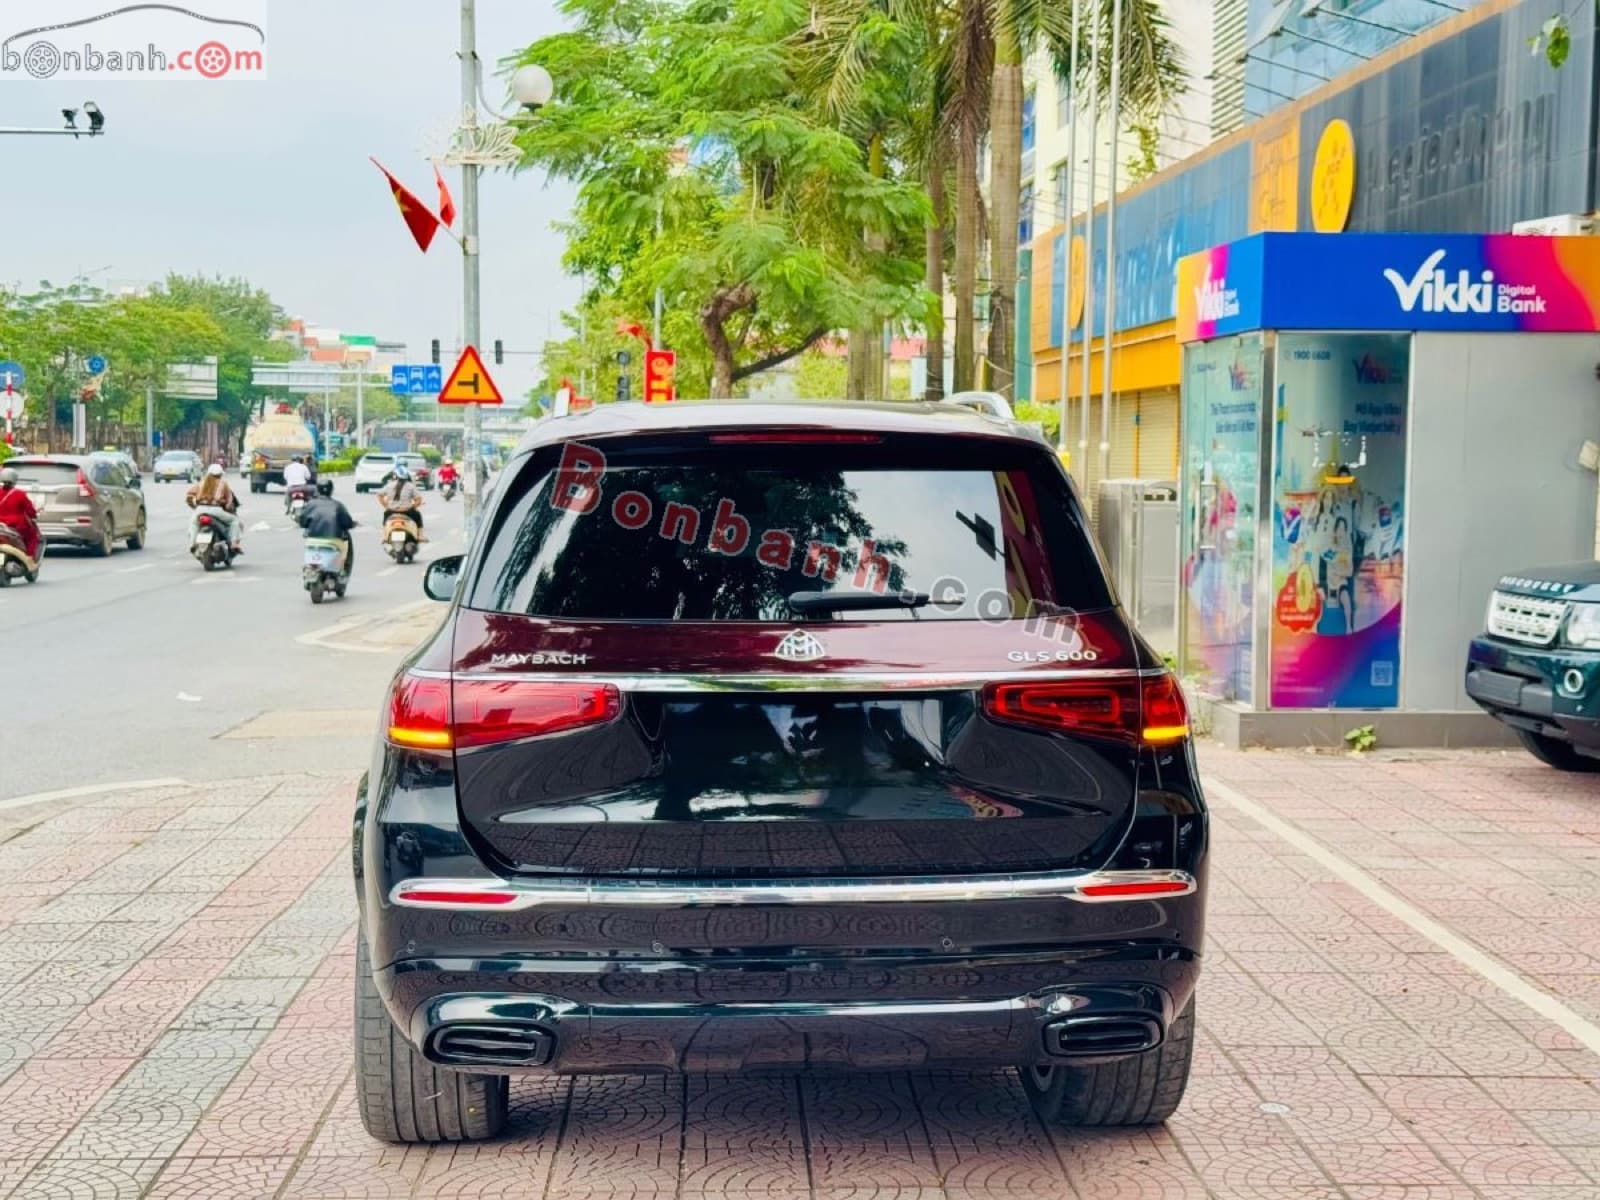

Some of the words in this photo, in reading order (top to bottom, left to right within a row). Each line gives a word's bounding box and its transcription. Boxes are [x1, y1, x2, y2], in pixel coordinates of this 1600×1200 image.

[1384, 249, 1494, 313] Vikki
[1497, 284, 1536, 297] Digital
[1497, 296, 1547, 313] Bank
[490, 653, 587, 665] MAYBACH
[1007, 650, 1051, 663] GLS
[1055, 650, 1097, 661] 600
